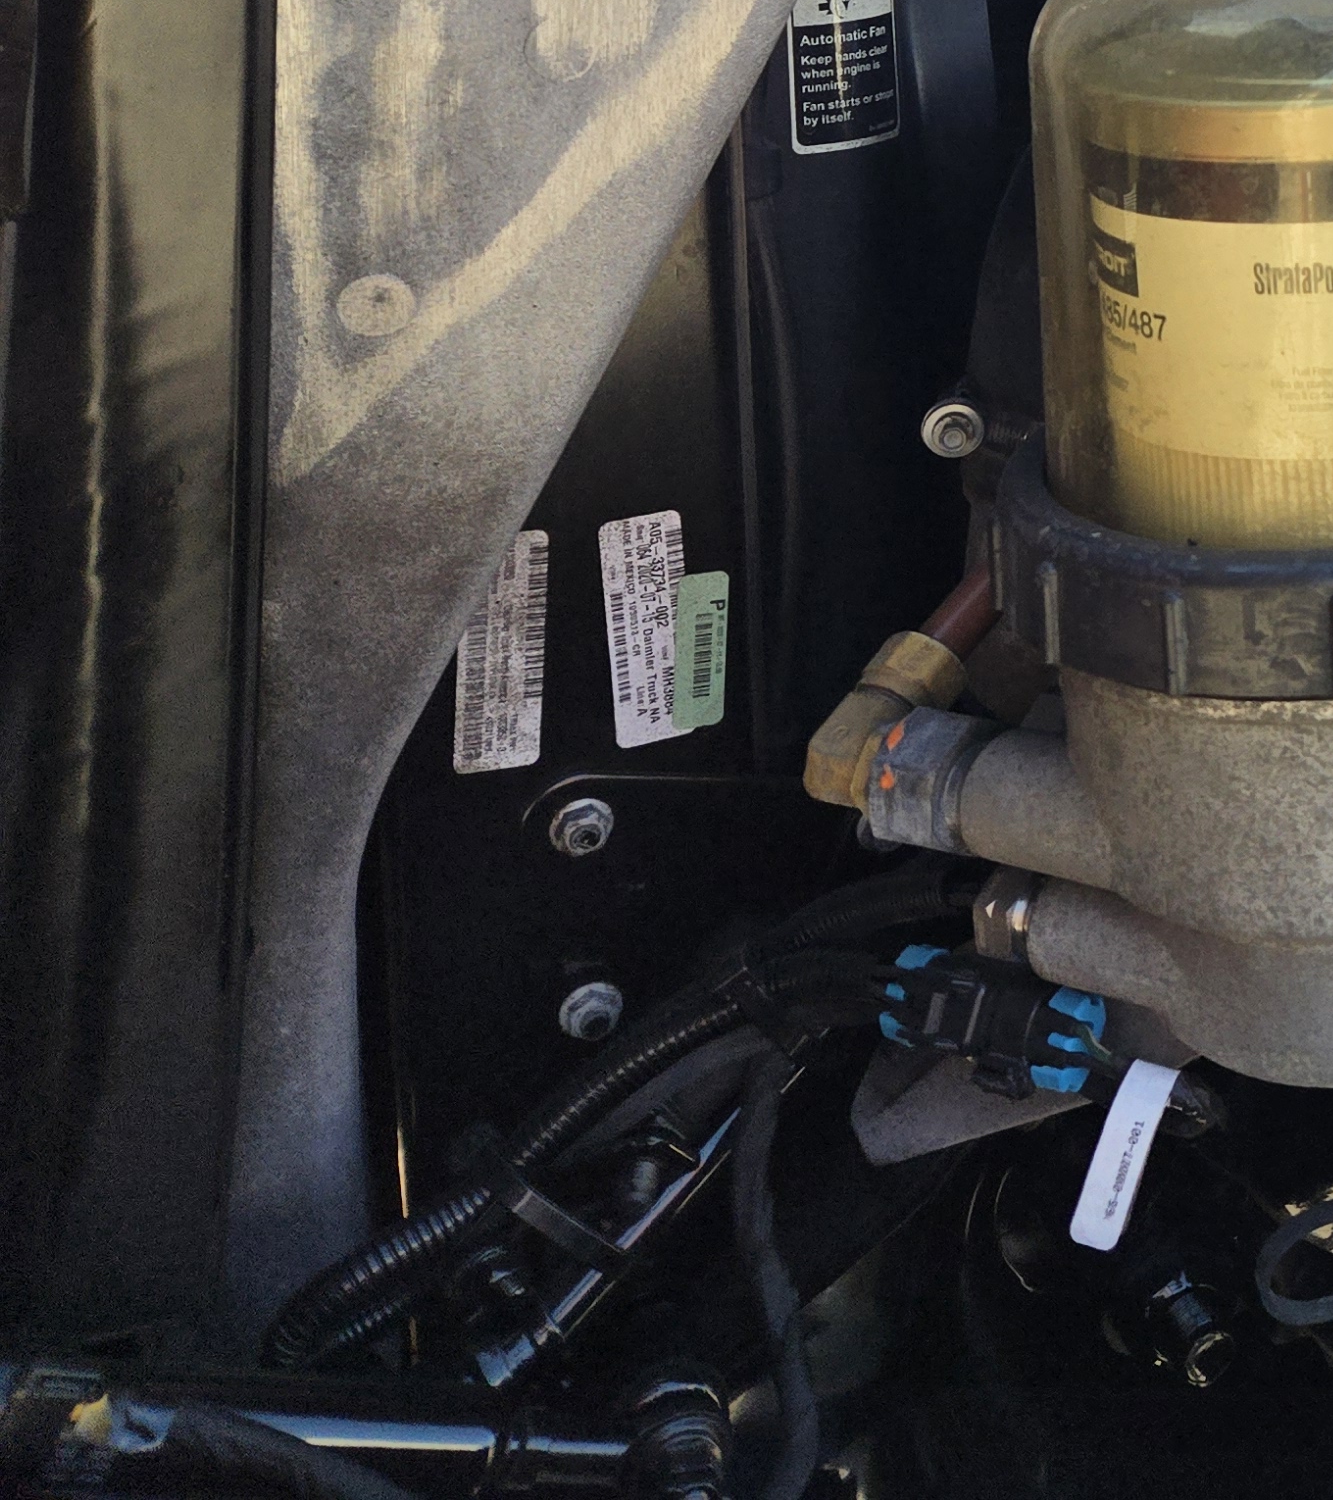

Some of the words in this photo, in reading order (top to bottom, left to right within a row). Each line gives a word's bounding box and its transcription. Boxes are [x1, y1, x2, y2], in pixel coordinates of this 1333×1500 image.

[800, 28, 867, 47] Automatic
[869, 25, 886, 38] Fan
[800, 55, 832, 67] Keep
[836, 49, 867, 62] hands
[868, 45, 888, 56] clear
[801, 68, 834, 80] when
[836, 64, 871, 77] engine
[872, 60, 880, 70] is
[802, 81, 851, 94] running.
[803, 101, 825, 113] Fan
[828, 97, 861, 110] starts
[862, 94, 874, 104] or
[803, 115, 819, 127] by
[821, 111, 854, 125] itself.
[622, 520, 632, 546] MADE
[624, 560, 636, 596] MEXICO
[710, 599, 726, 612] P
[642, 629, 655, 671] Daimler
[647, 673, 659, 706] Truck
[637, 708, 648, 717] A
[649, 708, 661, 725] NA
